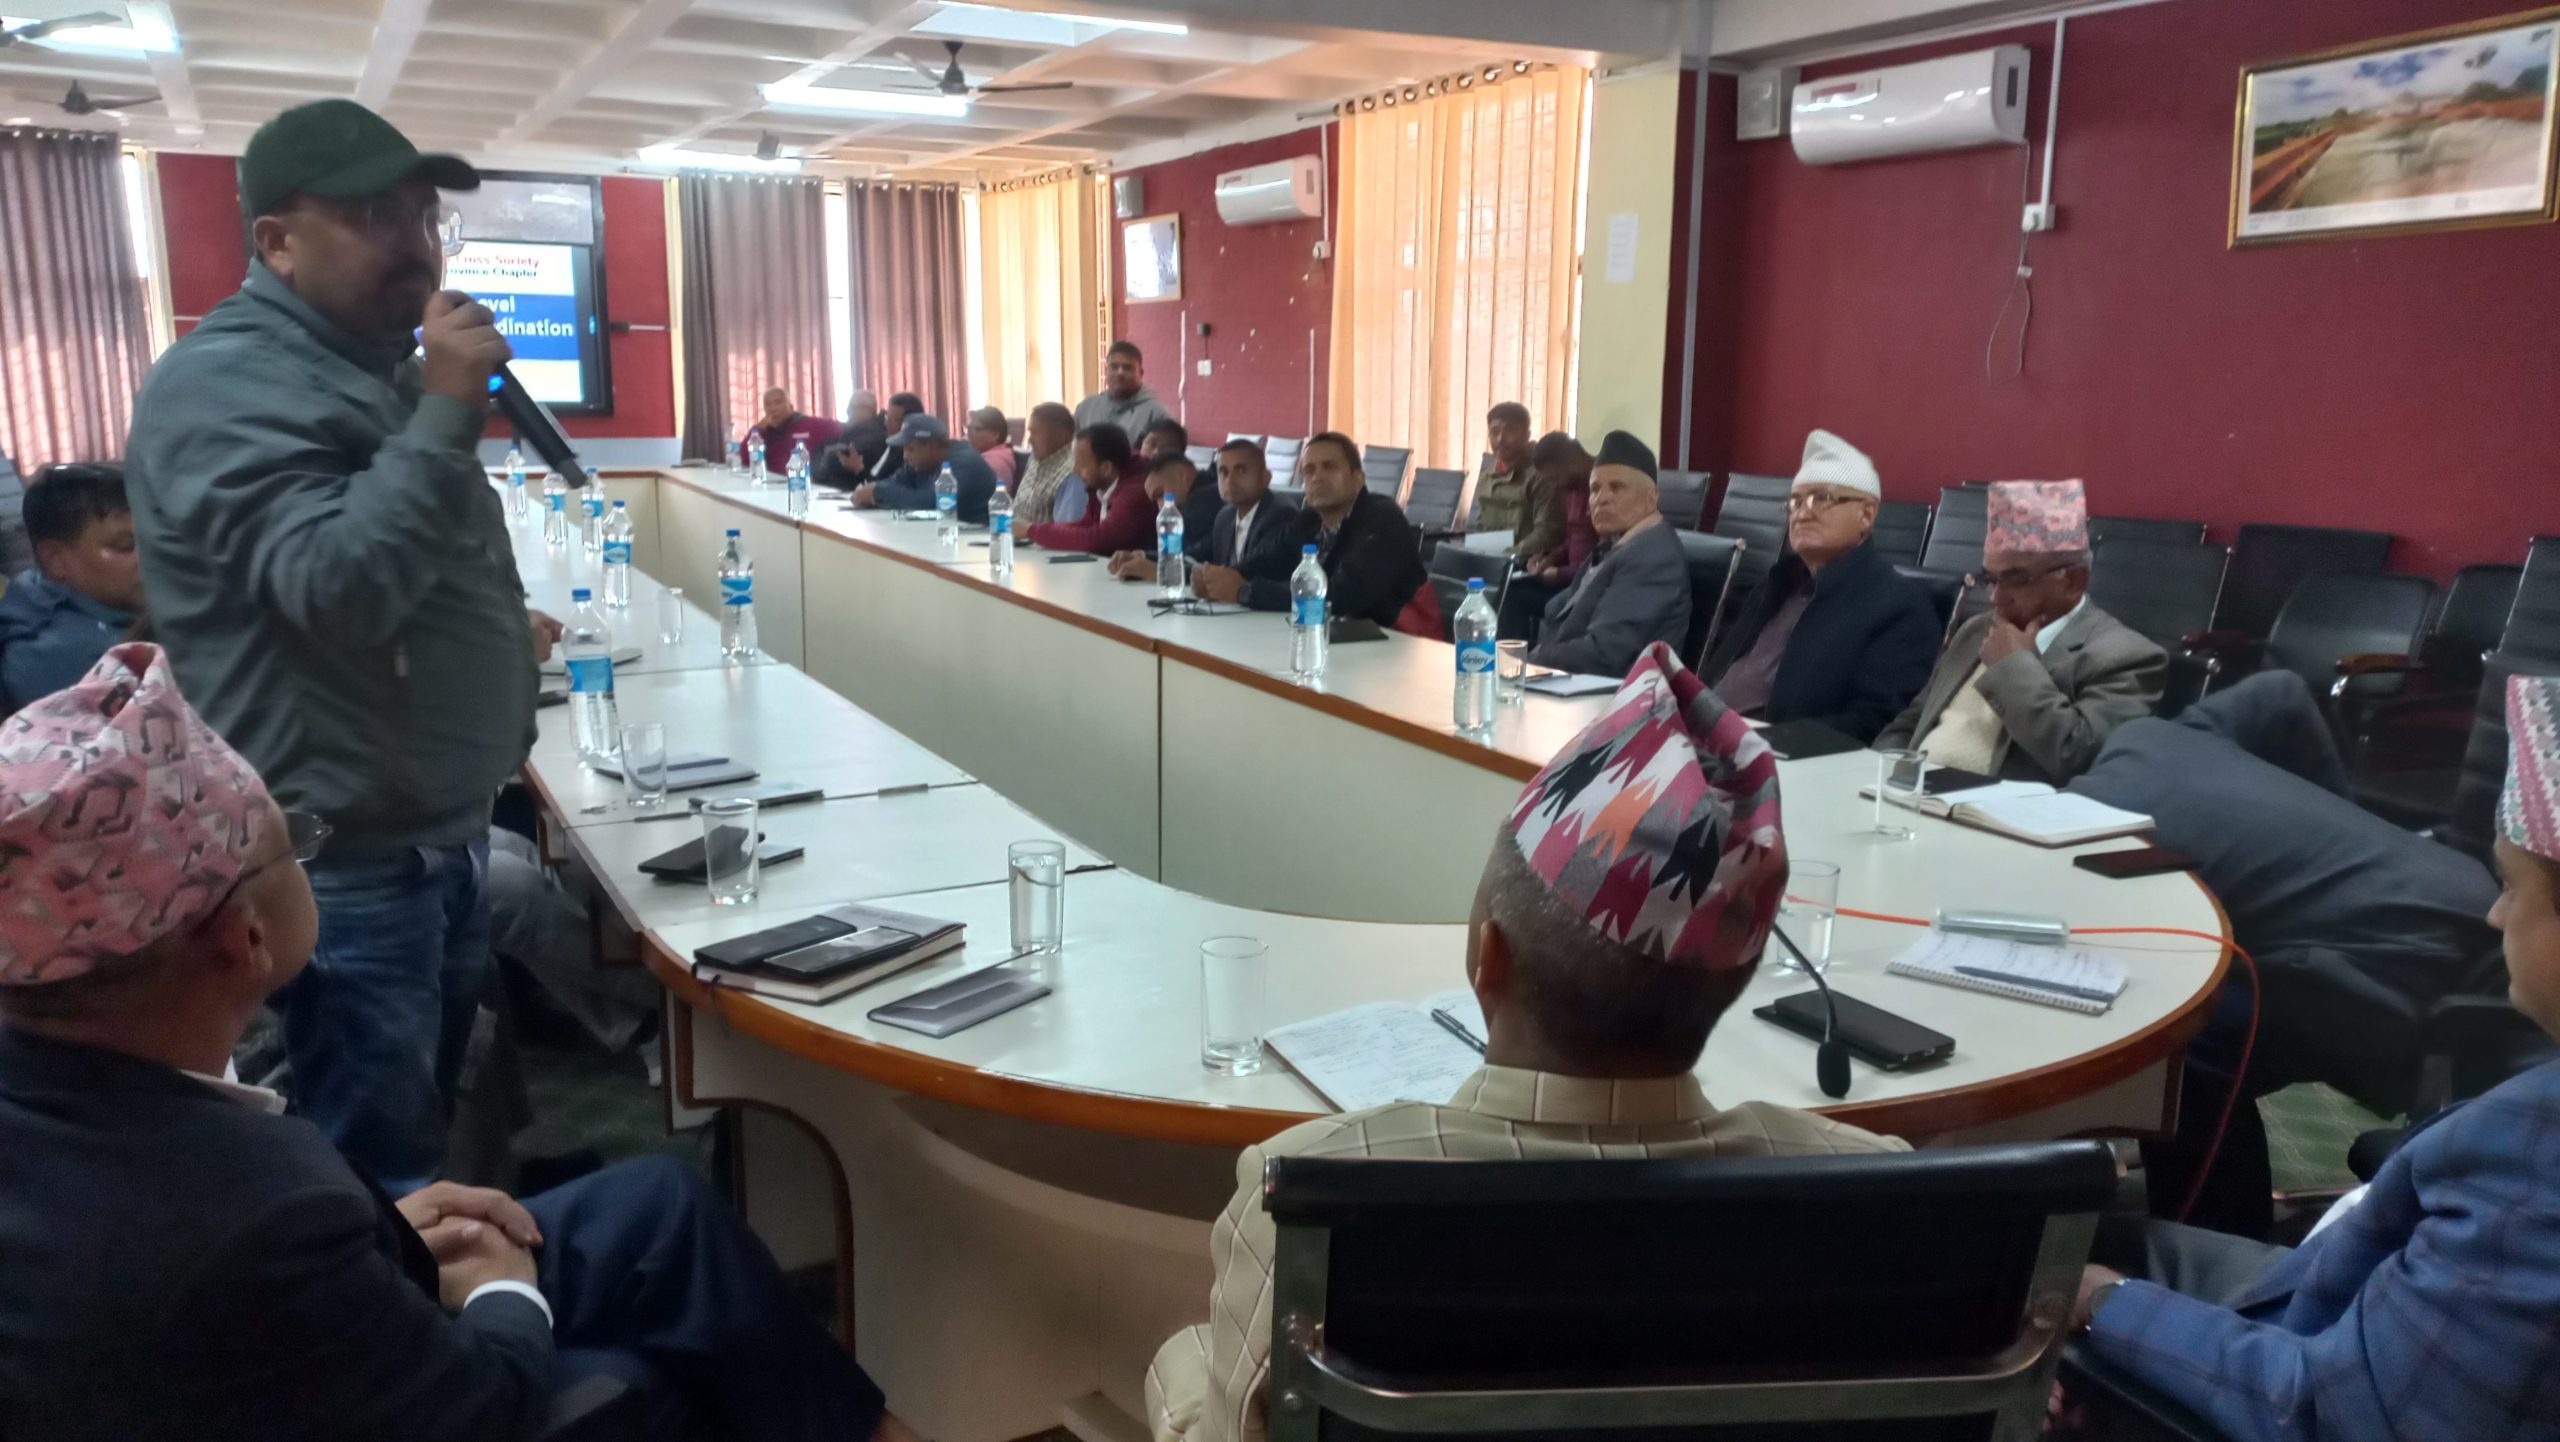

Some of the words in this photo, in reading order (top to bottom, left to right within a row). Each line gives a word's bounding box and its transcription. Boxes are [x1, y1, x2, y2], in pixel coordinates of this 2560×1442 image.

[495, 255, 539, 268] Society
[449, 267, 489, 276] ovince
[493, 268, 537, 278] Chapter
[477, 295, 516, 313] evel
[494, 316, 574, 337] dination
